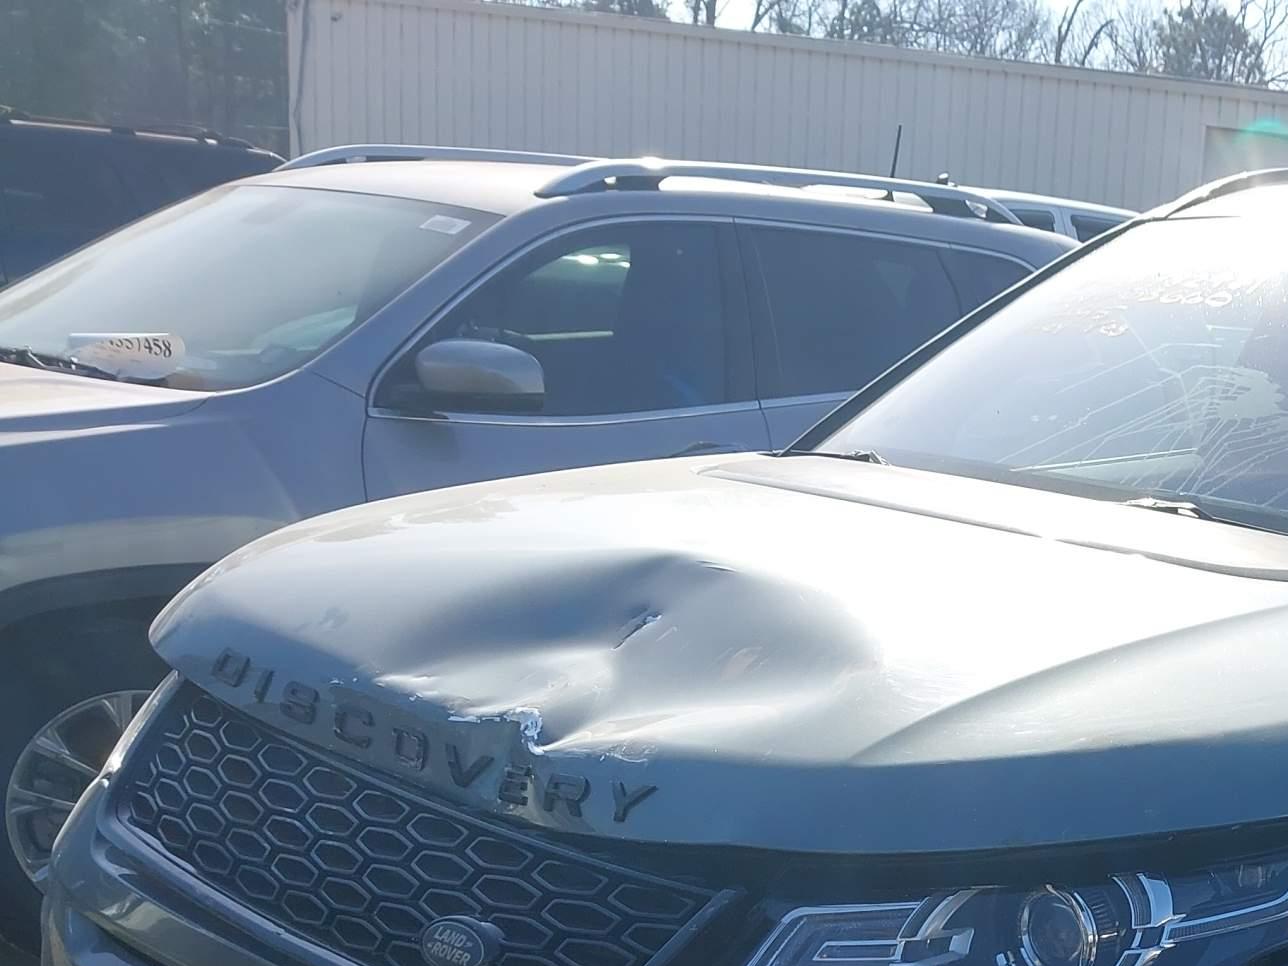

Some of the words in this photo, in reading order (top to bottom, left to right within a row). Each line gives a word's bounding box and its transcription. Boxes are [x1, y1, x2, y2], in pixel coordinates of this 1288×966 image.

[211, 647, 659, 823] DISCOVERY
[433, 926, 467, 947] LAND
[431, 942, 471, 966] ROVER
